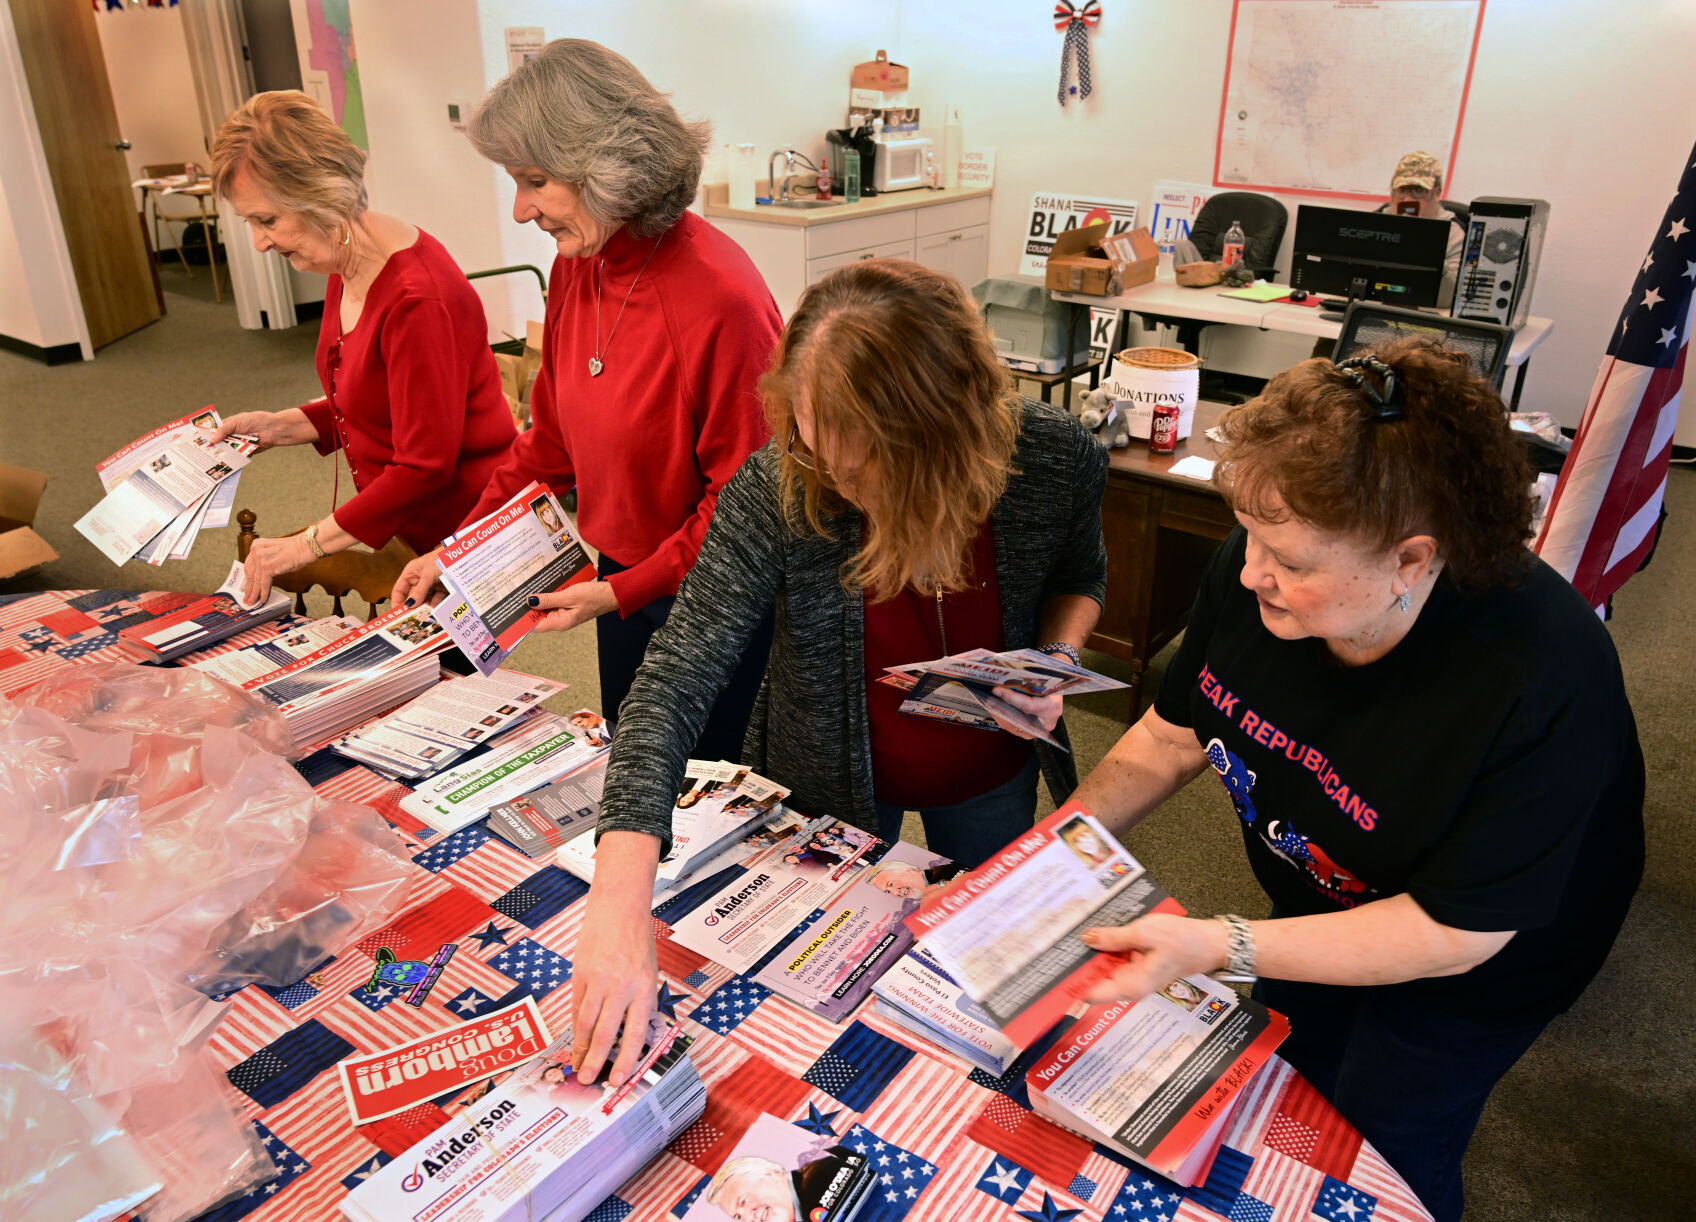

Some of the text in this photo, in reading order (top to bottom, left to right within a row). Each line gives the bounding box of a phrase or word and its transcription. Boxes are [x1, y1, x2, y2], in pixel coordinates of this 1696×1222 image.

[1034, 196, 1072, 211] SHANA
[1339, 228, 1400, 243] SCEPTRE
[1114, 382, 1184, 404] DONATIONS
[102, 457, 116, 467] You
[117, 448, 130, 458] Can
[132, 434, 154, 448] Count
[155, 426, 167, 435] On
[445, 504, 524, 560] You Can Count On Me!
[293, 655, 315, 670] FOR
[318, 634, 356, 656] CHUCK
[359, 606, 410, 634] BROERMA
[456, 616, 470, 630] WHO
[462, 630, 471, 638] TO
[450, 774, 496, 802] CHAMPION
[496, 768, 506, 776] OF
[506, 758, 525, 770] THE
[522, 734, 570, 760] TAXPAYER
[1240, 709, 1380, 832] REPUBLICANS
[714, 874, 770, 918] Anderson
[714, 896, 728, 908] PAM
[727, 898, 754, 920] SECRETARY
[761, 880, 776, 892] STATE
[789, 940, 822, 970] POLITICAL
[821, 910, 852, 938] OUTSIDER
[794, 906, 870, 980] WHO WILL TAKE THE FIGHT
[804, 920, 870, 986] TO BENNET AND BIDEN
[836, 980, 853, 996] LEARN
[901, 966, 925, 984] County
[908, 986, 934, 1005] TEAM
[920, 970, 941, 986] Voters
[926, 983, 942, 995] Paso
[888, 985, 993, 1050] VOTE FOR THE WINNING
[936, 1002, 986, 1034] STATEWIDE
[1199, 998, 1226, 1023] BLACK
[355, 1010, 526, 1076] U.S. CONGRESS
[356, 1016, 535, 1096] Lamborn
[458, 1037, 540, 1079] Doug
[1036, 1006, 1123, 1081] You Can Count On
[422, 1100, 516, 1178] Anderson
[424, 1139, 448, 1158] PAM
[436, 1110, 522, 1183] SECRETARY OF STATE
[420, 1184, 468, 1222] LEADERSHIP
[468, 1172, 484, 1184] FOR
[524, 1112, 561, 1140] ELECTIONS
[818, 1166, 850, 1208] JOE O'DEA
[826, 1198, 836, 1210] FOR
[833, 1168, 854, 1198] COLORADO
